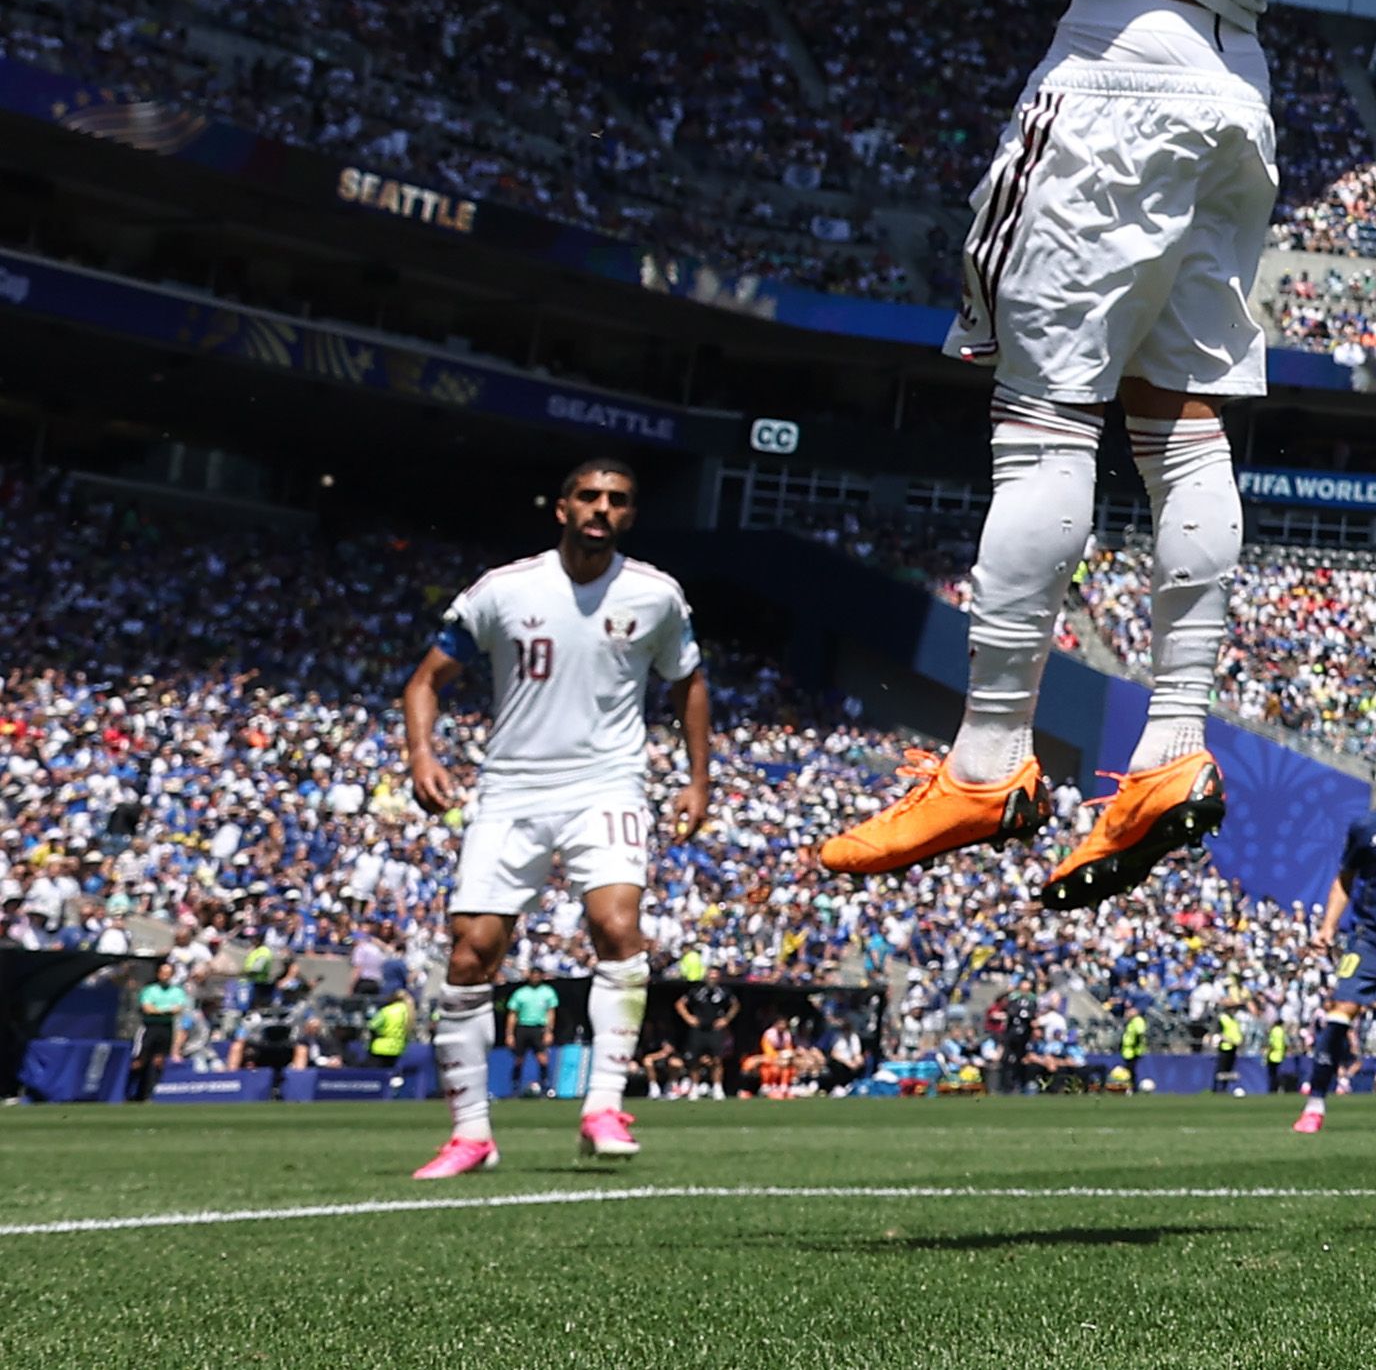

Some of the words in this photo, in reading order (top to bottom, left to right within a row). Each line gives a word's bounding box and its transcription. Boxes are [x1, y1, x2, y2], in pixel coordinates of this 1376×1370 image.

[337, 167, 478, 235] SEATTLE
[547, 393, 676, 441] SEATTLE
[756, 425, 793, 449] CC
[1239, 471, 1292, 497] FIFA
[514, 638, 553, 682] 10
[603, 810, 643, 846] 10
